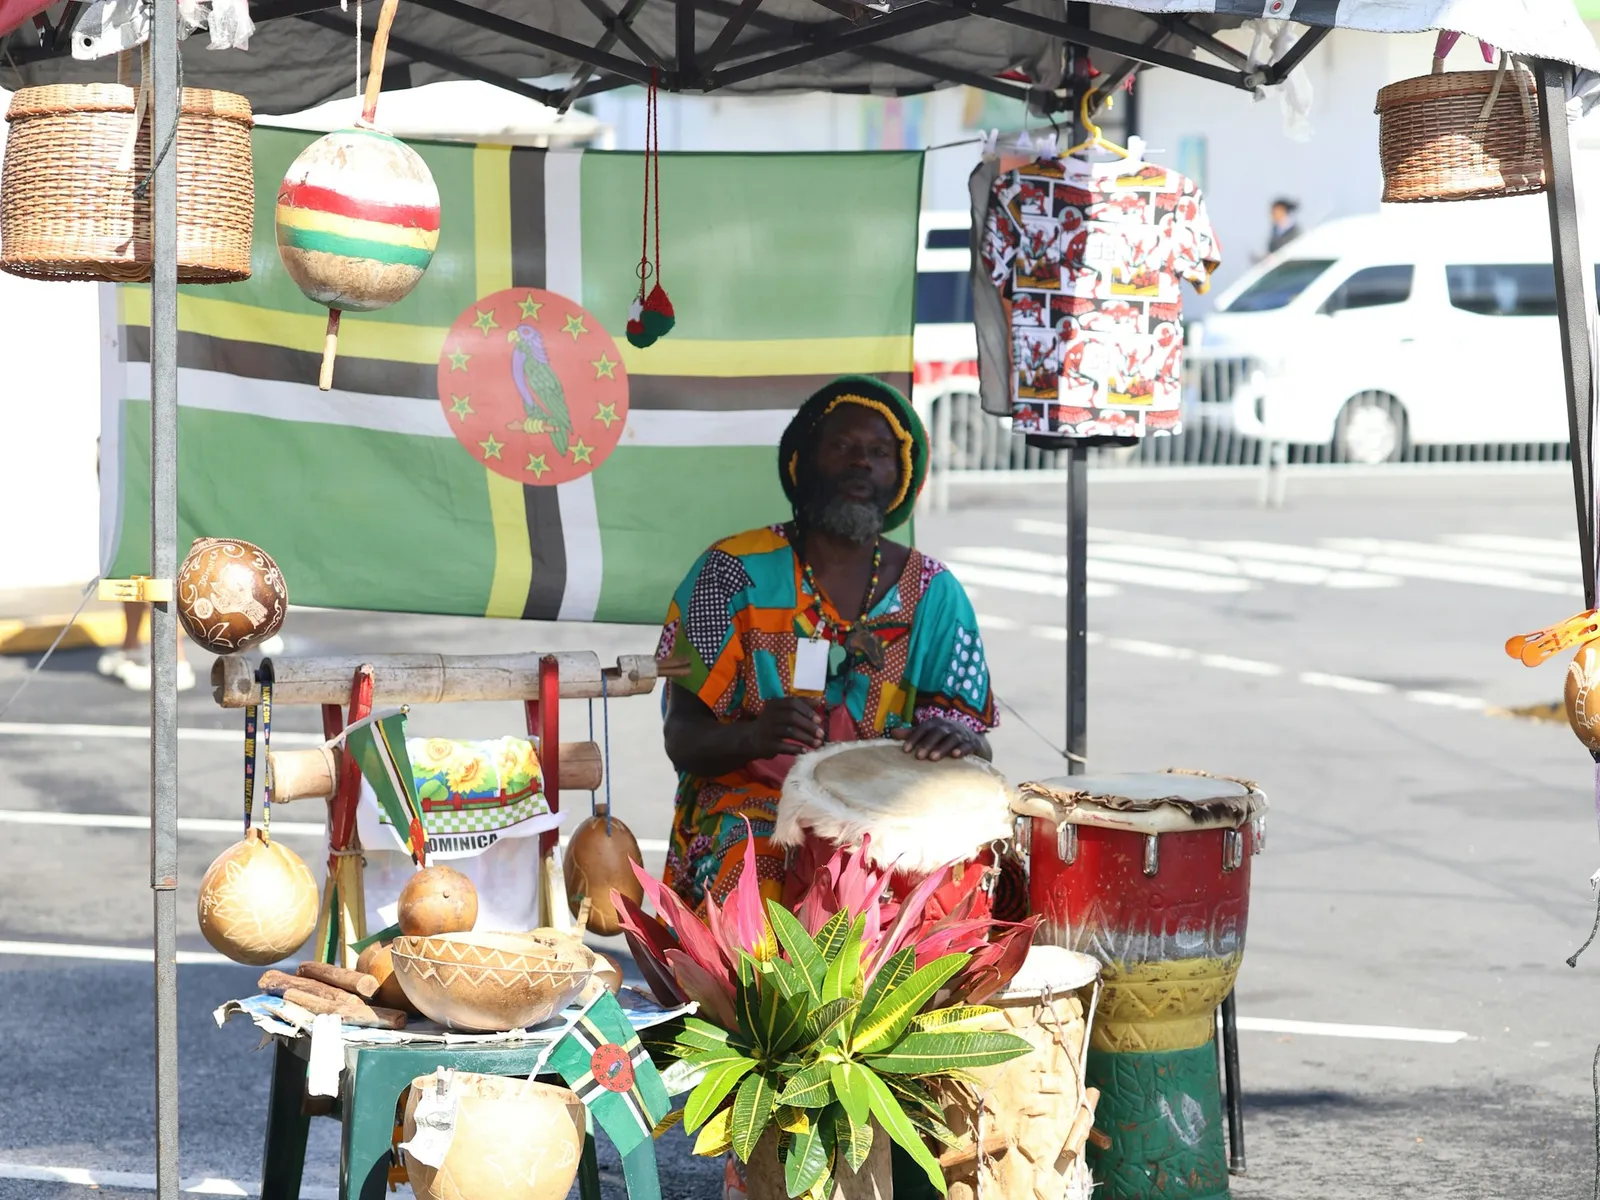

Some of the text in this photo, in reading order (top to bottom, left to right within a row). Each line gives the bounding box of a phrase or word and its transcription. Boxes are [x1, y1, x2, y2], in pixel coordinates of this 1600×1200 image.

[262, 686, 270, 723] NAVY.COM
[245, 738, 254, 758] NAVY
[245, 778, 253, 814] NAVY.COM
[428, 833, 498, 852] OMINICA
